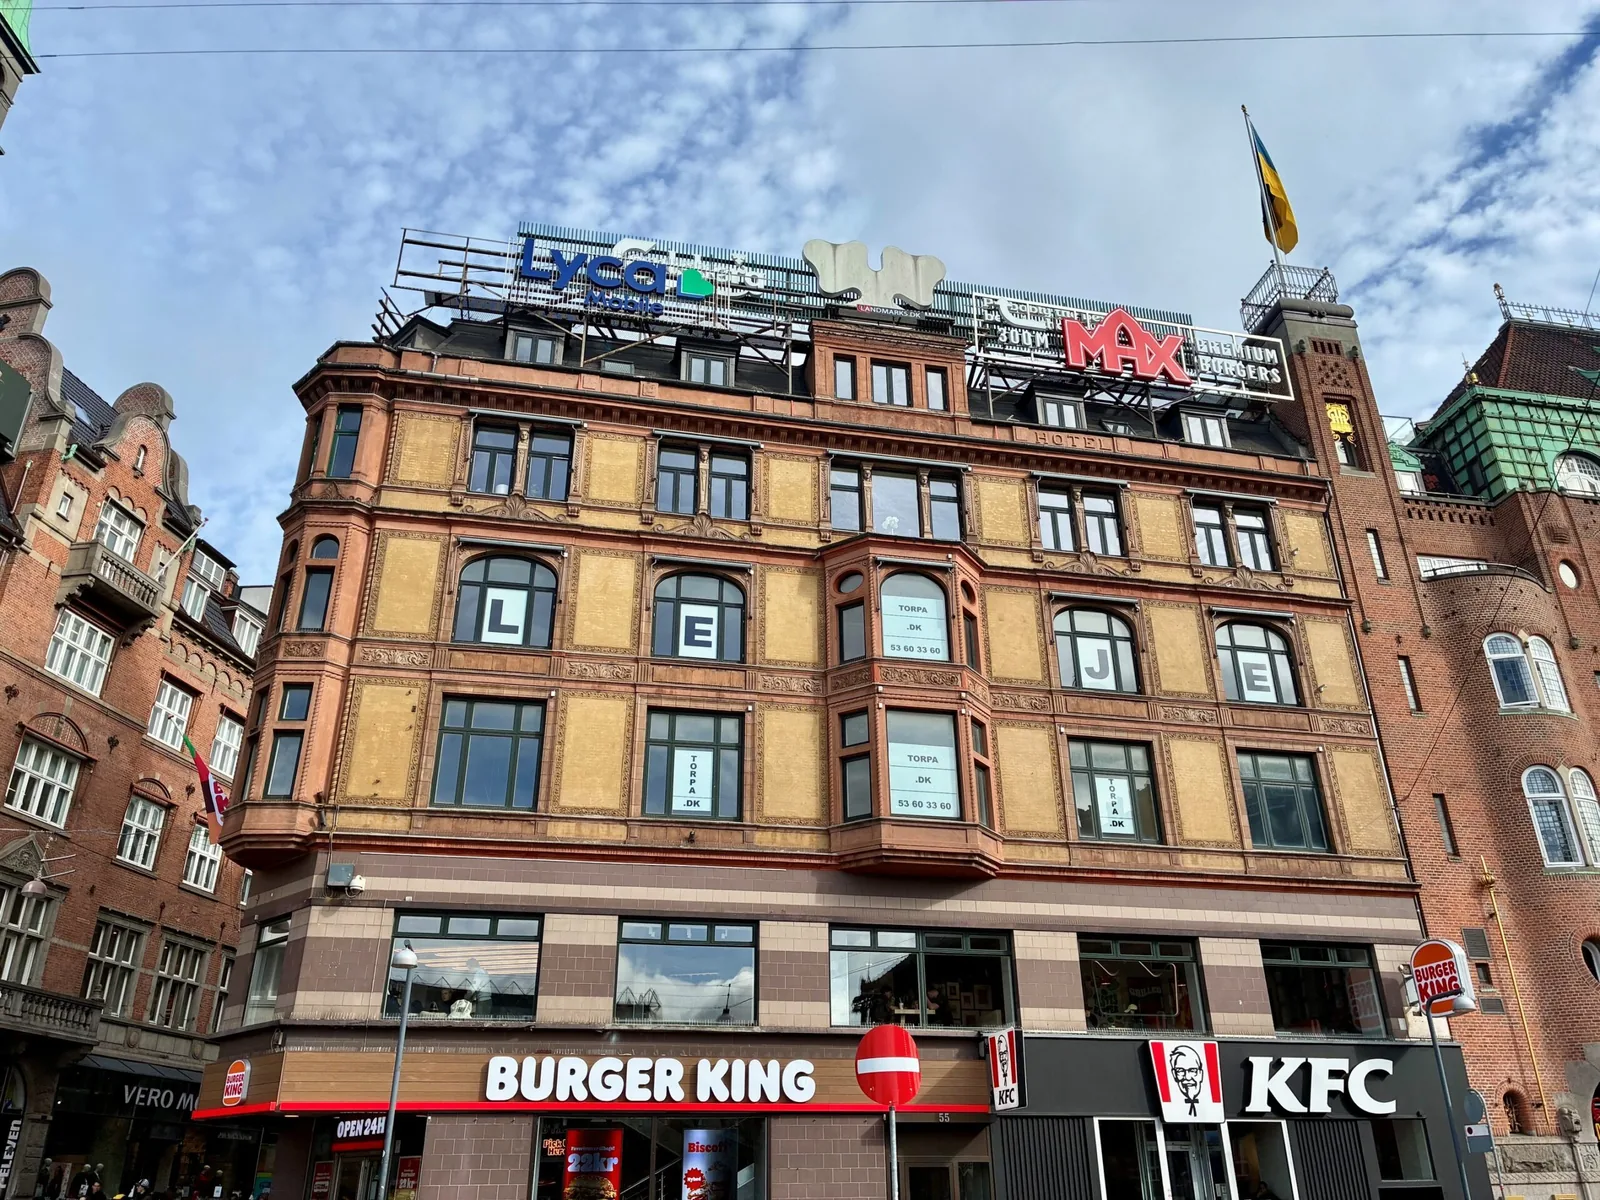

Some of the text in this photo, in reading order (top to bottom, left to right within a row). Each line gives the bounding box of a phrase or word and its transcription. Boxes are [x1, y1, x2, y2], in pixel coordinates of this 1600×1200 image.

[520, 238, 667, 293] Lyca
[583, 289, 664, 317] Mobile
[859, 304, 921, 319] LANDMARKS.DK
[1061, 306, 1192, 386] MAX
[1196, 339, 1279, 366] PREMIUM
[1198, 355, 1282, 384] BURGERS
[488, 598, 520, 635] L
[898, 604, 928, 614] TORPA
[684, 615, 714, 648] E
[906, 624, 922, 632] .DK
[890, 644, 941, 655] 53 60 33 60
[1084, 649, 1110, 680] J
[1243, 662, 1271, 693] E
[907, 754, 939, 764] TORPA
[688, 755, 698, 795] TORPA
[915, 776, 932, 784] .DK
[683, 799, 701, 808] .DK
[898, 799, 952, 811] 53 60 33 60
[1108, 778, 1119, 815] TORPA
[1109, 820, 1125, 828] .DK
[1414, 960, 1457, 982] BURGER
[1417, 976, 1461, 1003] KING
[224, 1083, 243, 1097] KING
[226, 1073, 245, 1084] BURGER
[486, 1056, 816, 1103] BURGER KING
[1245, 1056, 1397, 1114] KFC
[124, 1084, 174, 1109] VERO
[998, 1087, 1015, 1106] KFC
[336, 1116, 387, 1139] OPEN 24H
[938, 1112, 950, 1123] 55
[567, 1152, 619, 1173] 22kr
